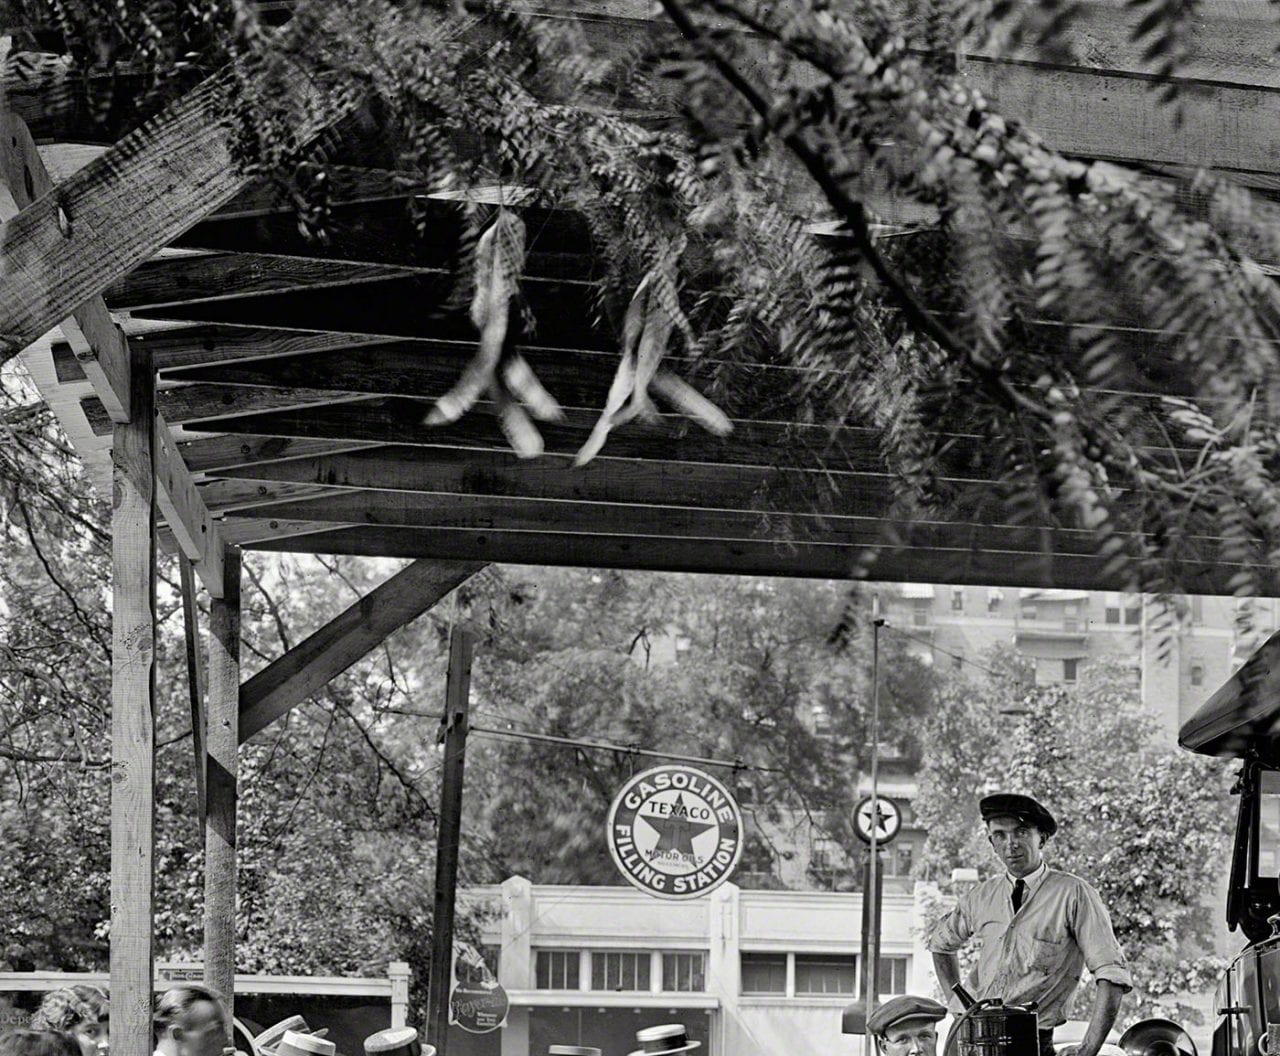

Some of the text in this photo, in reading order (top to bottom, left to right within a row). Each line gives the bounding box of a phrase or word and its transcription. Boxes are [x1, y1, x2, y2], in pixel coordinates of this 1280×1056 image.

[625, 773, 734, 823] GASOLINE
[649, 801, 710, 820] TEXACO
[615, 824, 735, 893] FILLING STATION
[645, 849, 705, 864] MOTOR OILS
